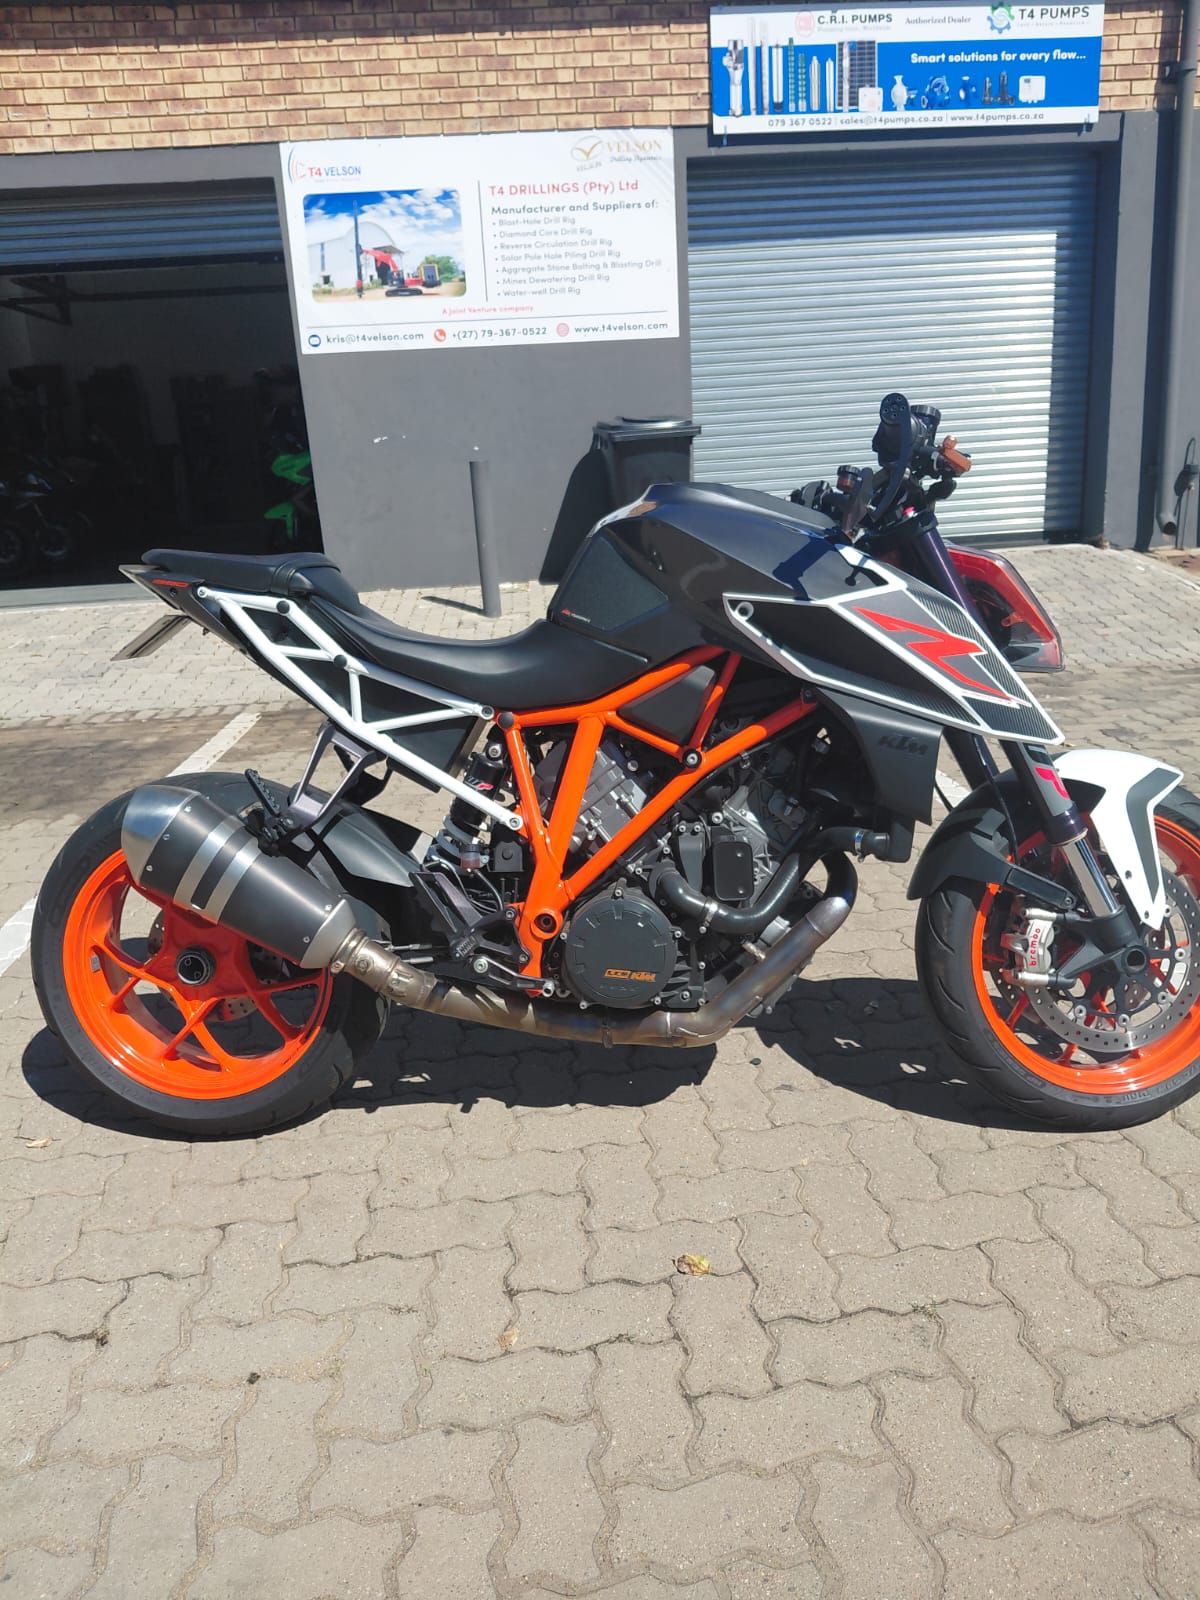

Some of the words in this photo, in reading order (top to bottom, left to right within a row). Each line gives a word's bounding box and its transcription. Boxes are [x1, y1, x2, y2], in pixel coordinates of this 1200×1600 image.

[817, 15, 848, 24] C.R.I.
[852, 14, 893, 23] PUMPS
[1018, 8, 1035, 20] T4
[1040, 6, 1090, 19] PUMPS
[905, 16, 946, 25] Authorized
[948, 16, 972, 24] Dealer
[911, 52, 946, 64] Smart
[948, 51, 998, 63] solutions
[1000, 51, 1017, 61] for
[1019, 52, 1050, 63] every
[1052, 49, 1086, 60] flow...
[768, 119, 786, 127] 079
[789, 118, 806, 126] 367
[809, 117, 832, 125] 0522
[840, 115, 943, 125] sales@t4pumps.co.za
[951, 113, 1044, 122] www.t4pumps.co.za
[606, 140, 662, 152] VELSON
[308, 167, 322, 177] T4
[324, 166, 361, 177] VELSON
[489, 186, 505, 196] T4
[509, 182, 580, 196] DRILLINGS
[583, 181, 615, 195] (Pty)
[619, 180, 639, 191] Ltd
[491, 204, 566, 215] Manufacturer
[569, 202, 589, 212] and
[592, 200, 642, 212] Suppliers
[645, 199, 659, 209] of:
[544, 217, 560, 225] Drill
[563, 216, 576, 226] Rig
[499, 230, 536, 239] Diamond
[561, 227, 577, 236] Drill
[580, 227, 593, 237] Rig
[500, 242, 532, 250] Reverse
[534, 239, 579, 249] Circulation
[581, 238, 597, 247] Drill
[600, 238, 613, 247] Rig
[501, 254, 522, 262] Solar
[565, 250, 587, 261] Piling
[589, 249, 605, 258] Drill
[608, 249, 621, 259] Rig
[502, 264, 545, 275] Aggregate
[502, 277, 527, 285] Mines
[529, 274, 576, 285] Dewatering
[578, 273, 595, 282] Drill
[597, 273, 610, 283] Rig
[549, 286, 566, 295] Drill
[568, 286, 581, 296] Rig
[574, 321, 668, 334] www.t4velson.com
[326, 332, 424, 344] kris@t4velson.com
[452, 329, 478, 341] +(27)
[481, 327, 547, 339] 79-367-0522
[1028, 928, 1041, 967] brembo
